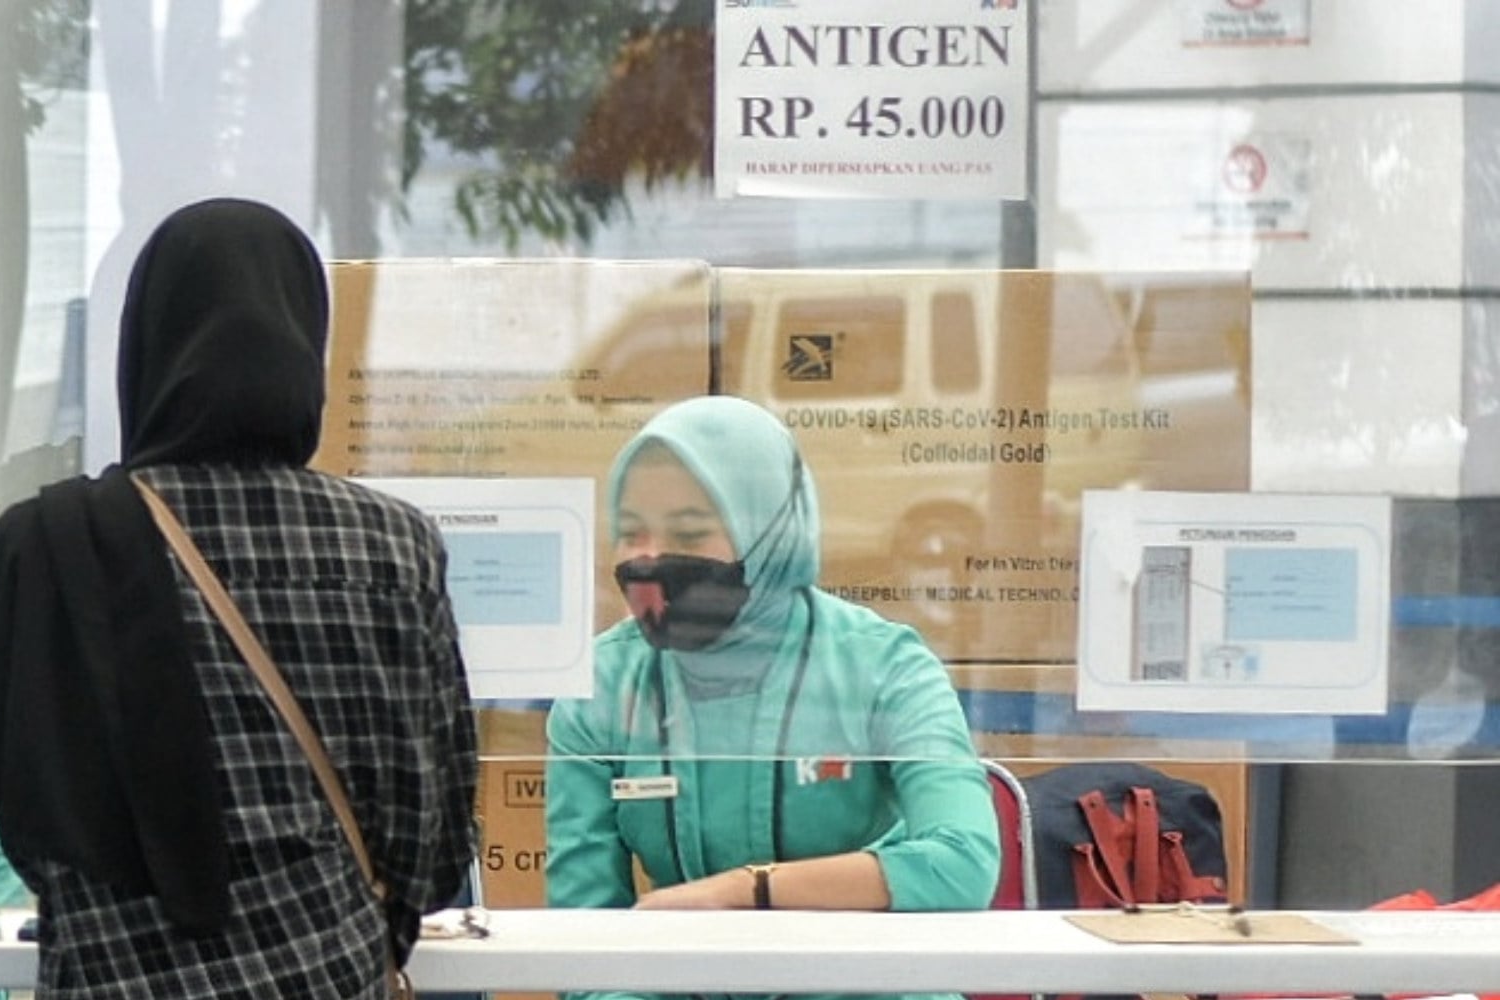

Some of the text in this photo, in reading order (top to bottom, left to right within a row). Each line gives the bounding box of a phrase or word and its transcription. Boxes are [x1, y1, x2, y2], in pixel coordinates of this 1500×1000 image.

[739, 25, 1013, 68] ANTIGEN
[738, 95, 1005, 138] RP. 45.000
[746, 162, 798, 175] HARAP
[786, 407, 878, 431] COVID-19
[1018, 407, 1093, 433] Antigen
[1099, 407, 1139, 429] Test
[1143, 407, 1170, 428] Kit
[966, 557, 989, 571] For
